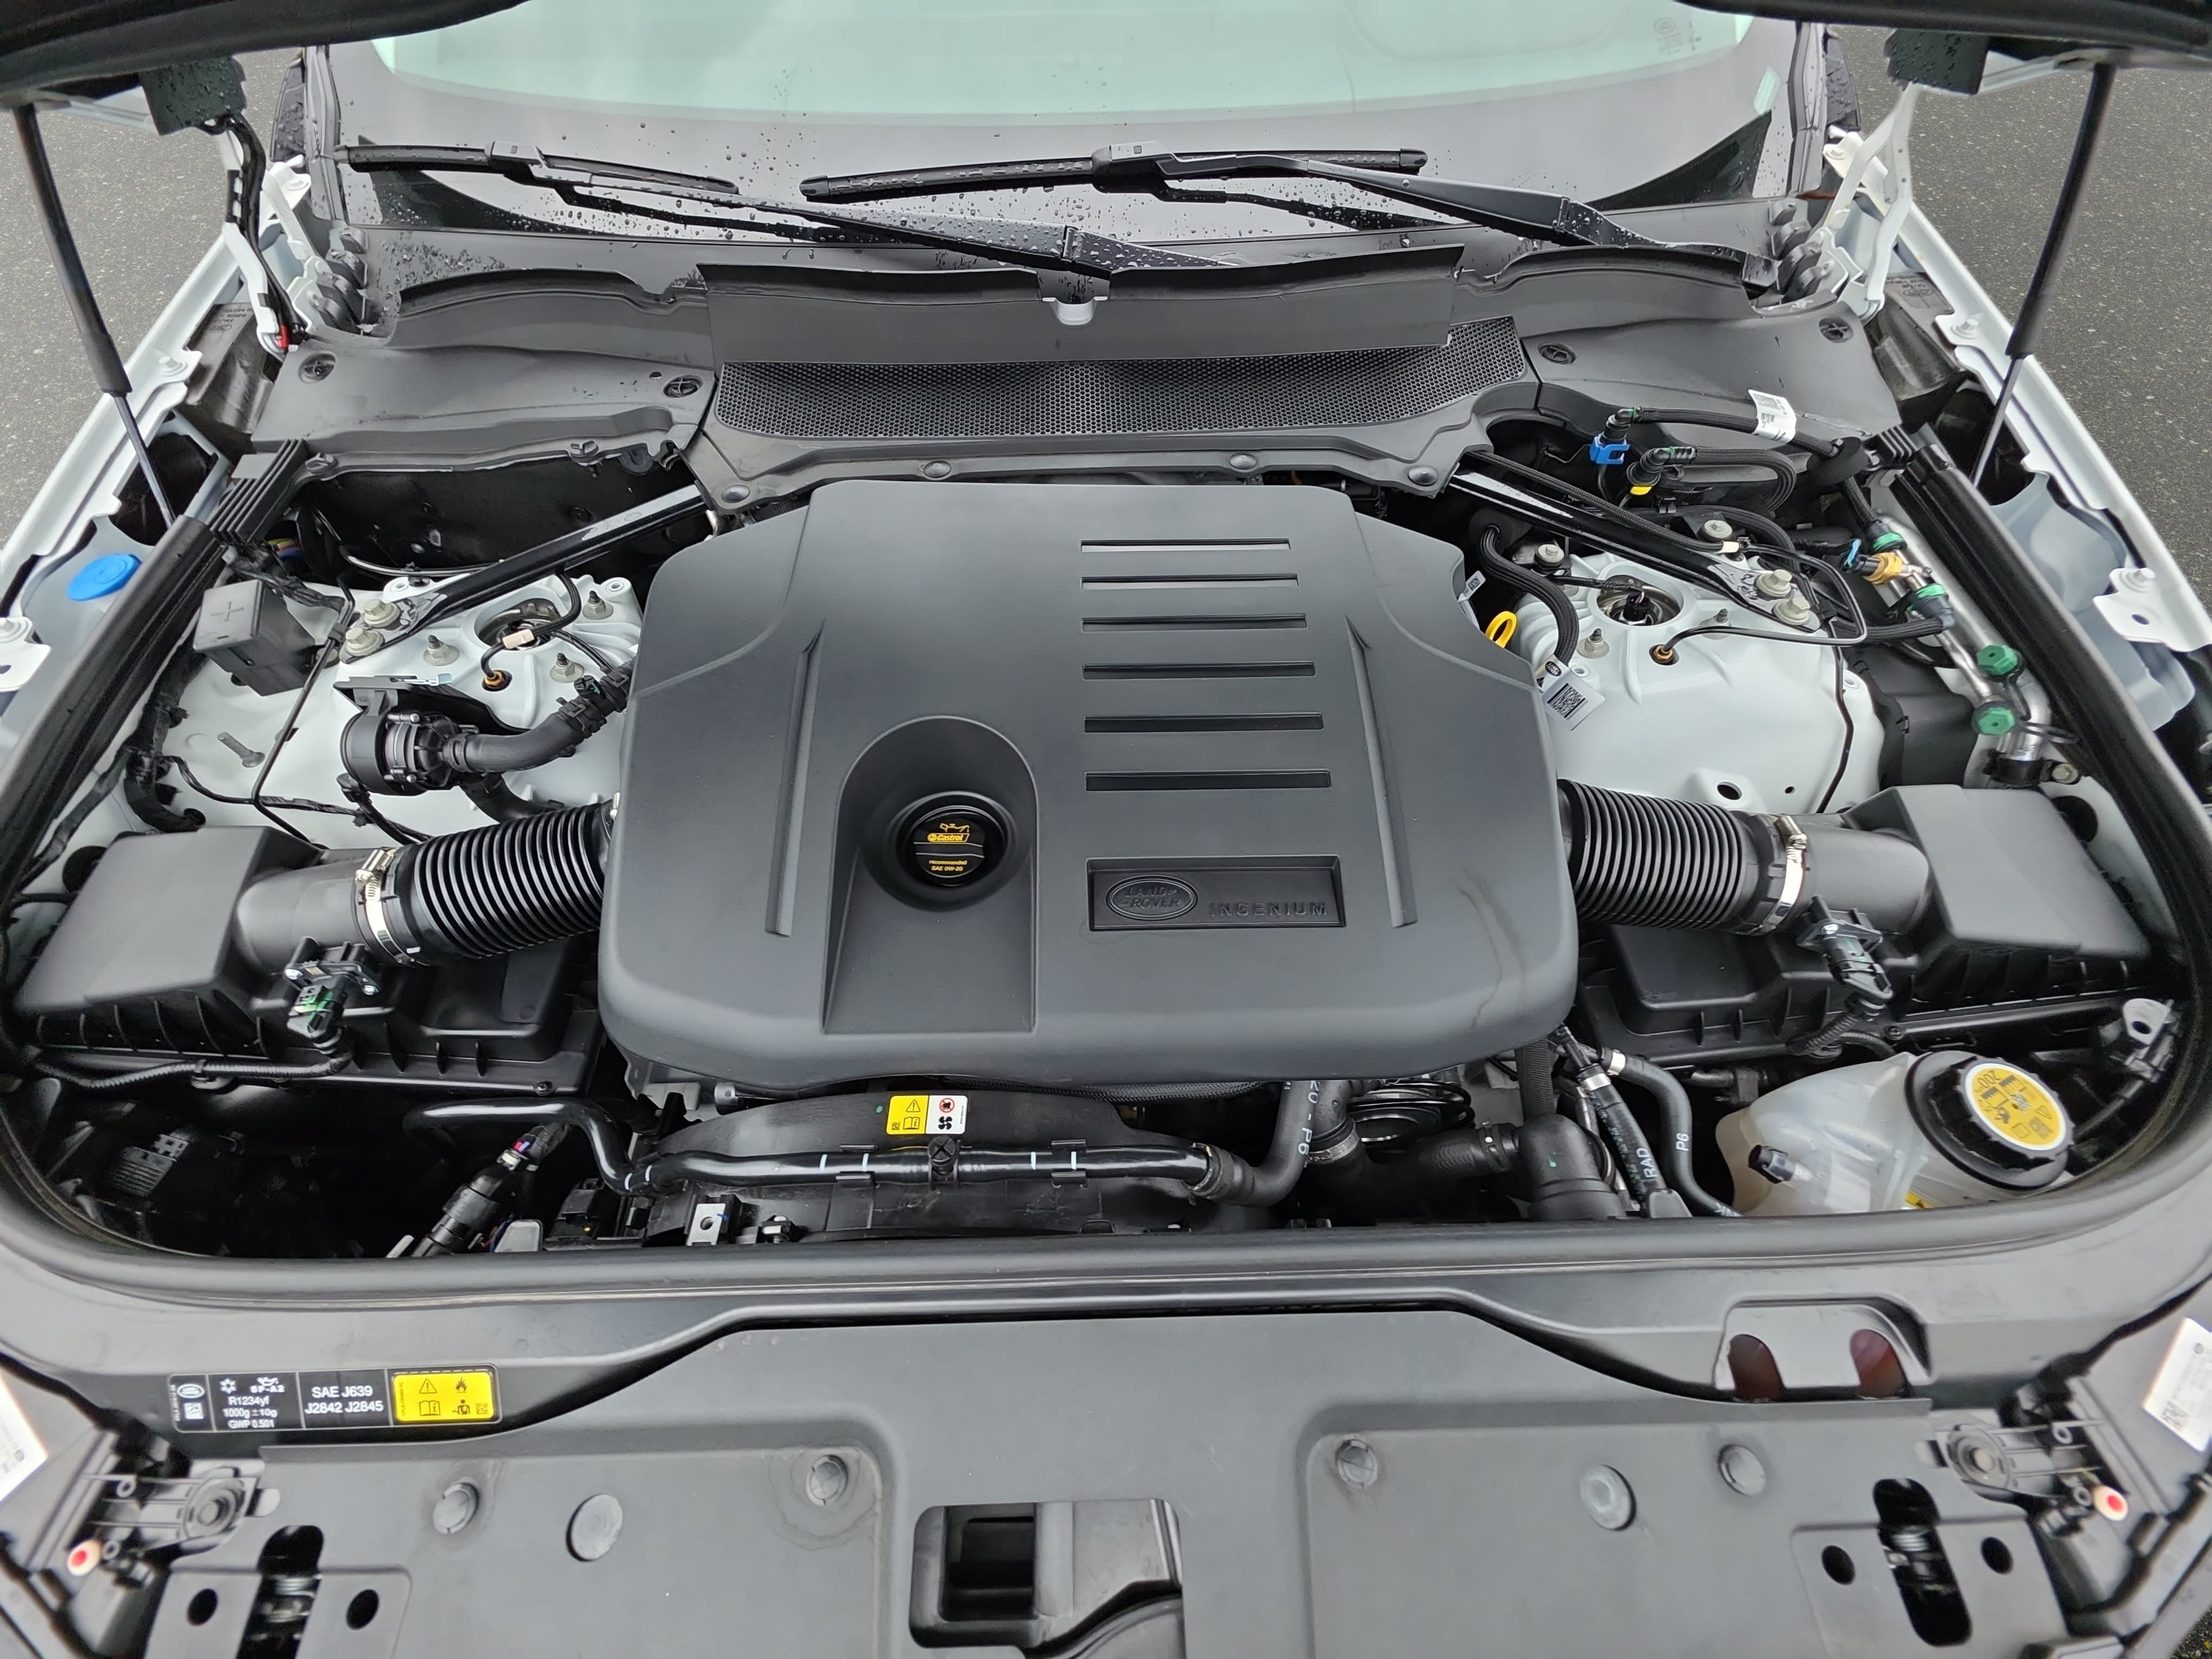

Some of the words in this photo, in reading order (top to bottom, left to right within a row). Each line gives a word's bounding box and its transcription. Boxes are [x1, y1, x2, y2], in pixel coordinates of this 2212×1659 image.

[1126, 886, 1167, 897] LAND
[1130, 898, 1181, 909] ROVER
[1209, 902, 1328, 916] INGENIUM
[1298, 1127, 1313, 1155] P6
[1676, 1133, 1689, 1152] P6
[1636, 1147, 1658, 1178] RAD
[311, 1386, 340, 1398] SAE
[341, 1385, 374, 1397] J639
[228, 1396, 270, 1406] R1234yf
[304, 1401, 343, 1414] J2842
[344, 1400, 384, 1413] J2845
[222, 1409, 251, 1419] 1000g
[227, 1420, 250, 1429] GWP
[252, 1419, 275, 1429] 0.501
